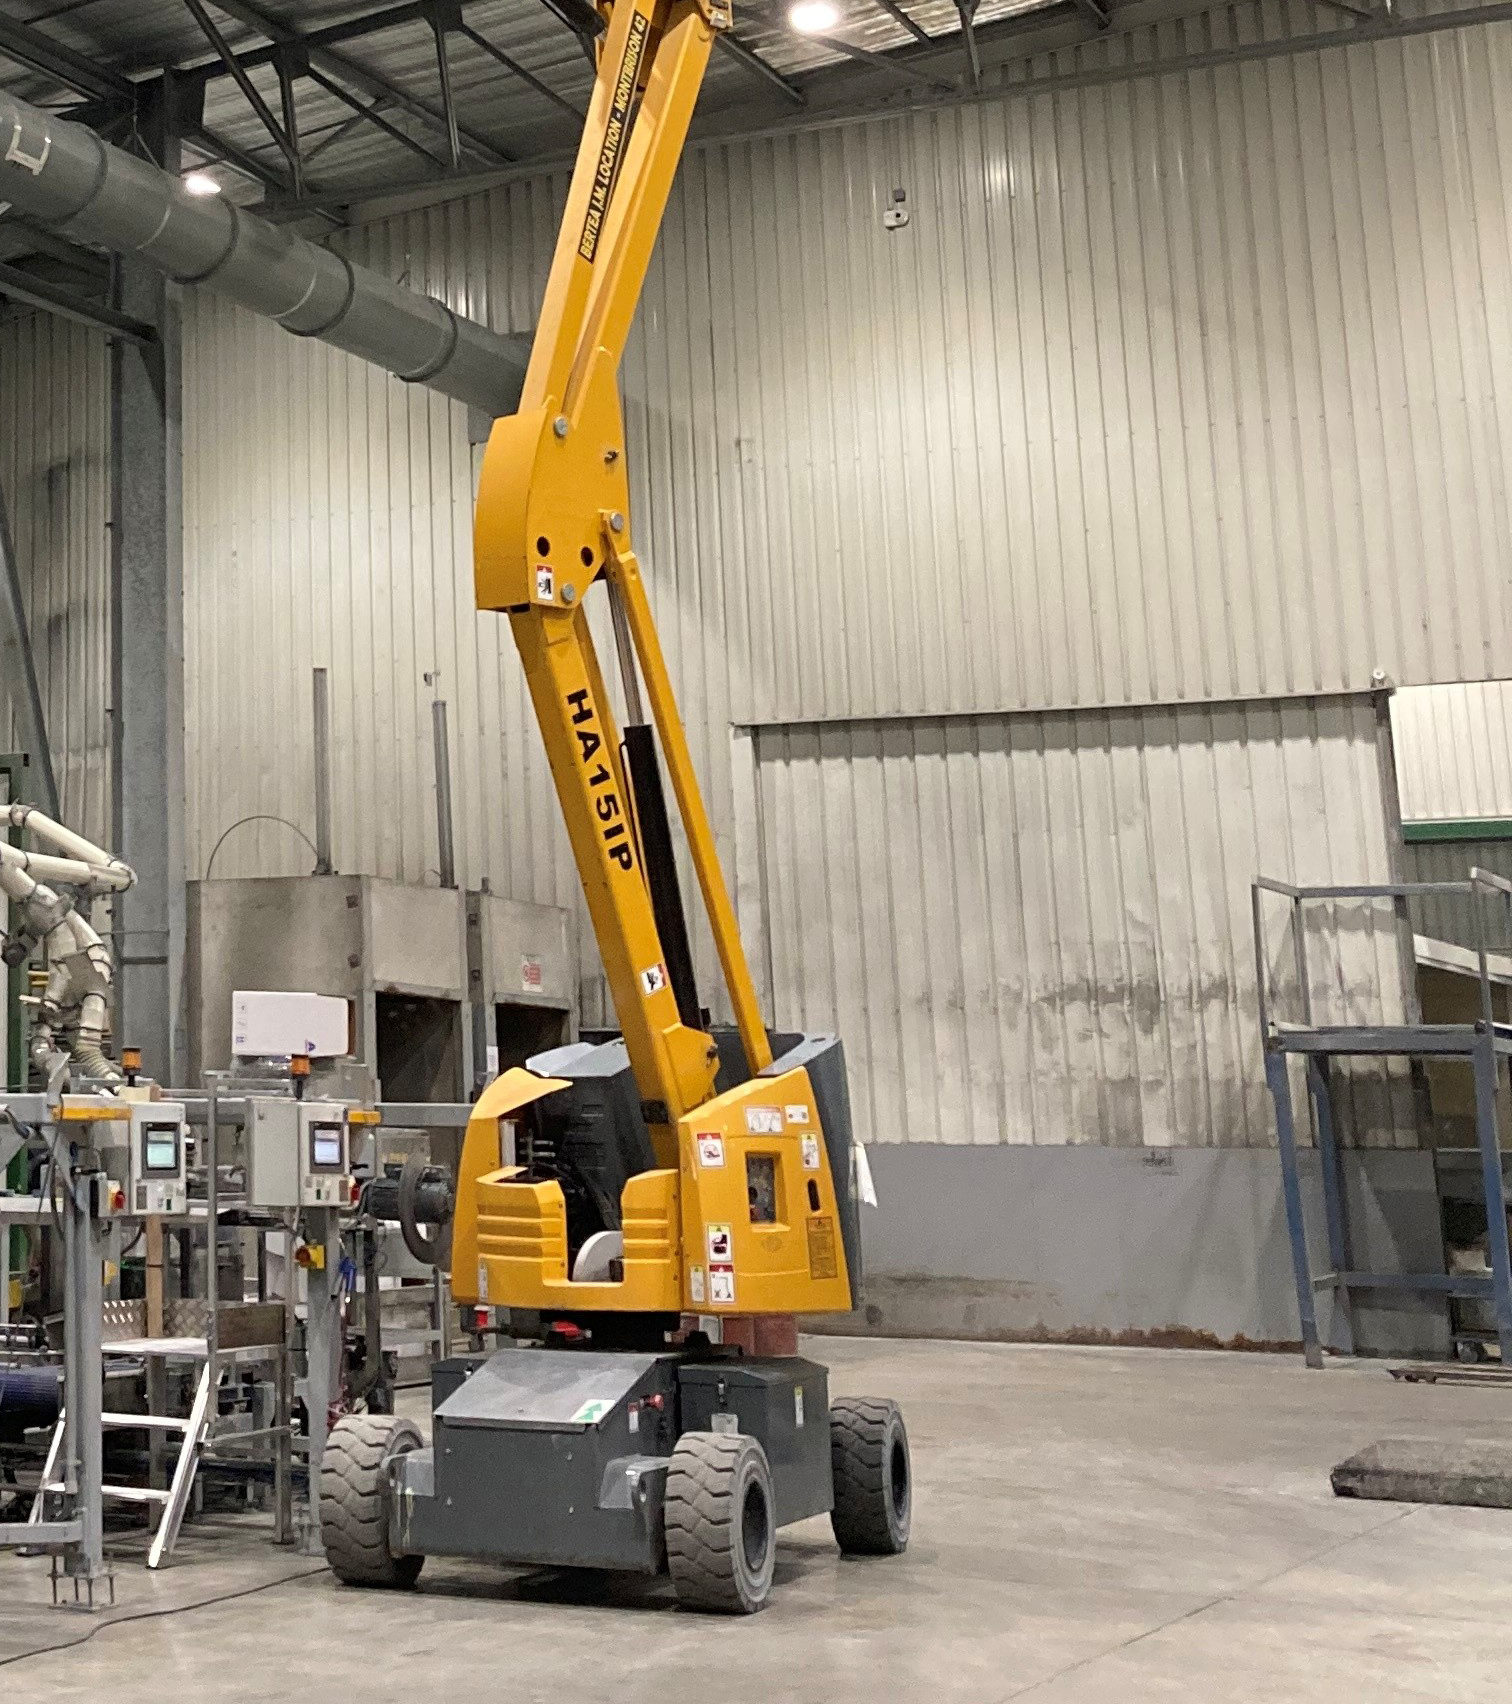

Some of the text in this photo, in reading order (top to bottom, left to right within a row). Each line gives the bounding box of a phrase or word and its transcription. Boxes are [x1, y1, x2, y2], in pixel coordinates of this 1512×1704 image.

[580, 208, 601, 260] BERTEA
[597, 117, 622, 183] LOCATION
[614, 30, 642, 113] MONTBRISON
[634, 15, 646, 32] 42
[567, 688, 633, 871] HA15IP
